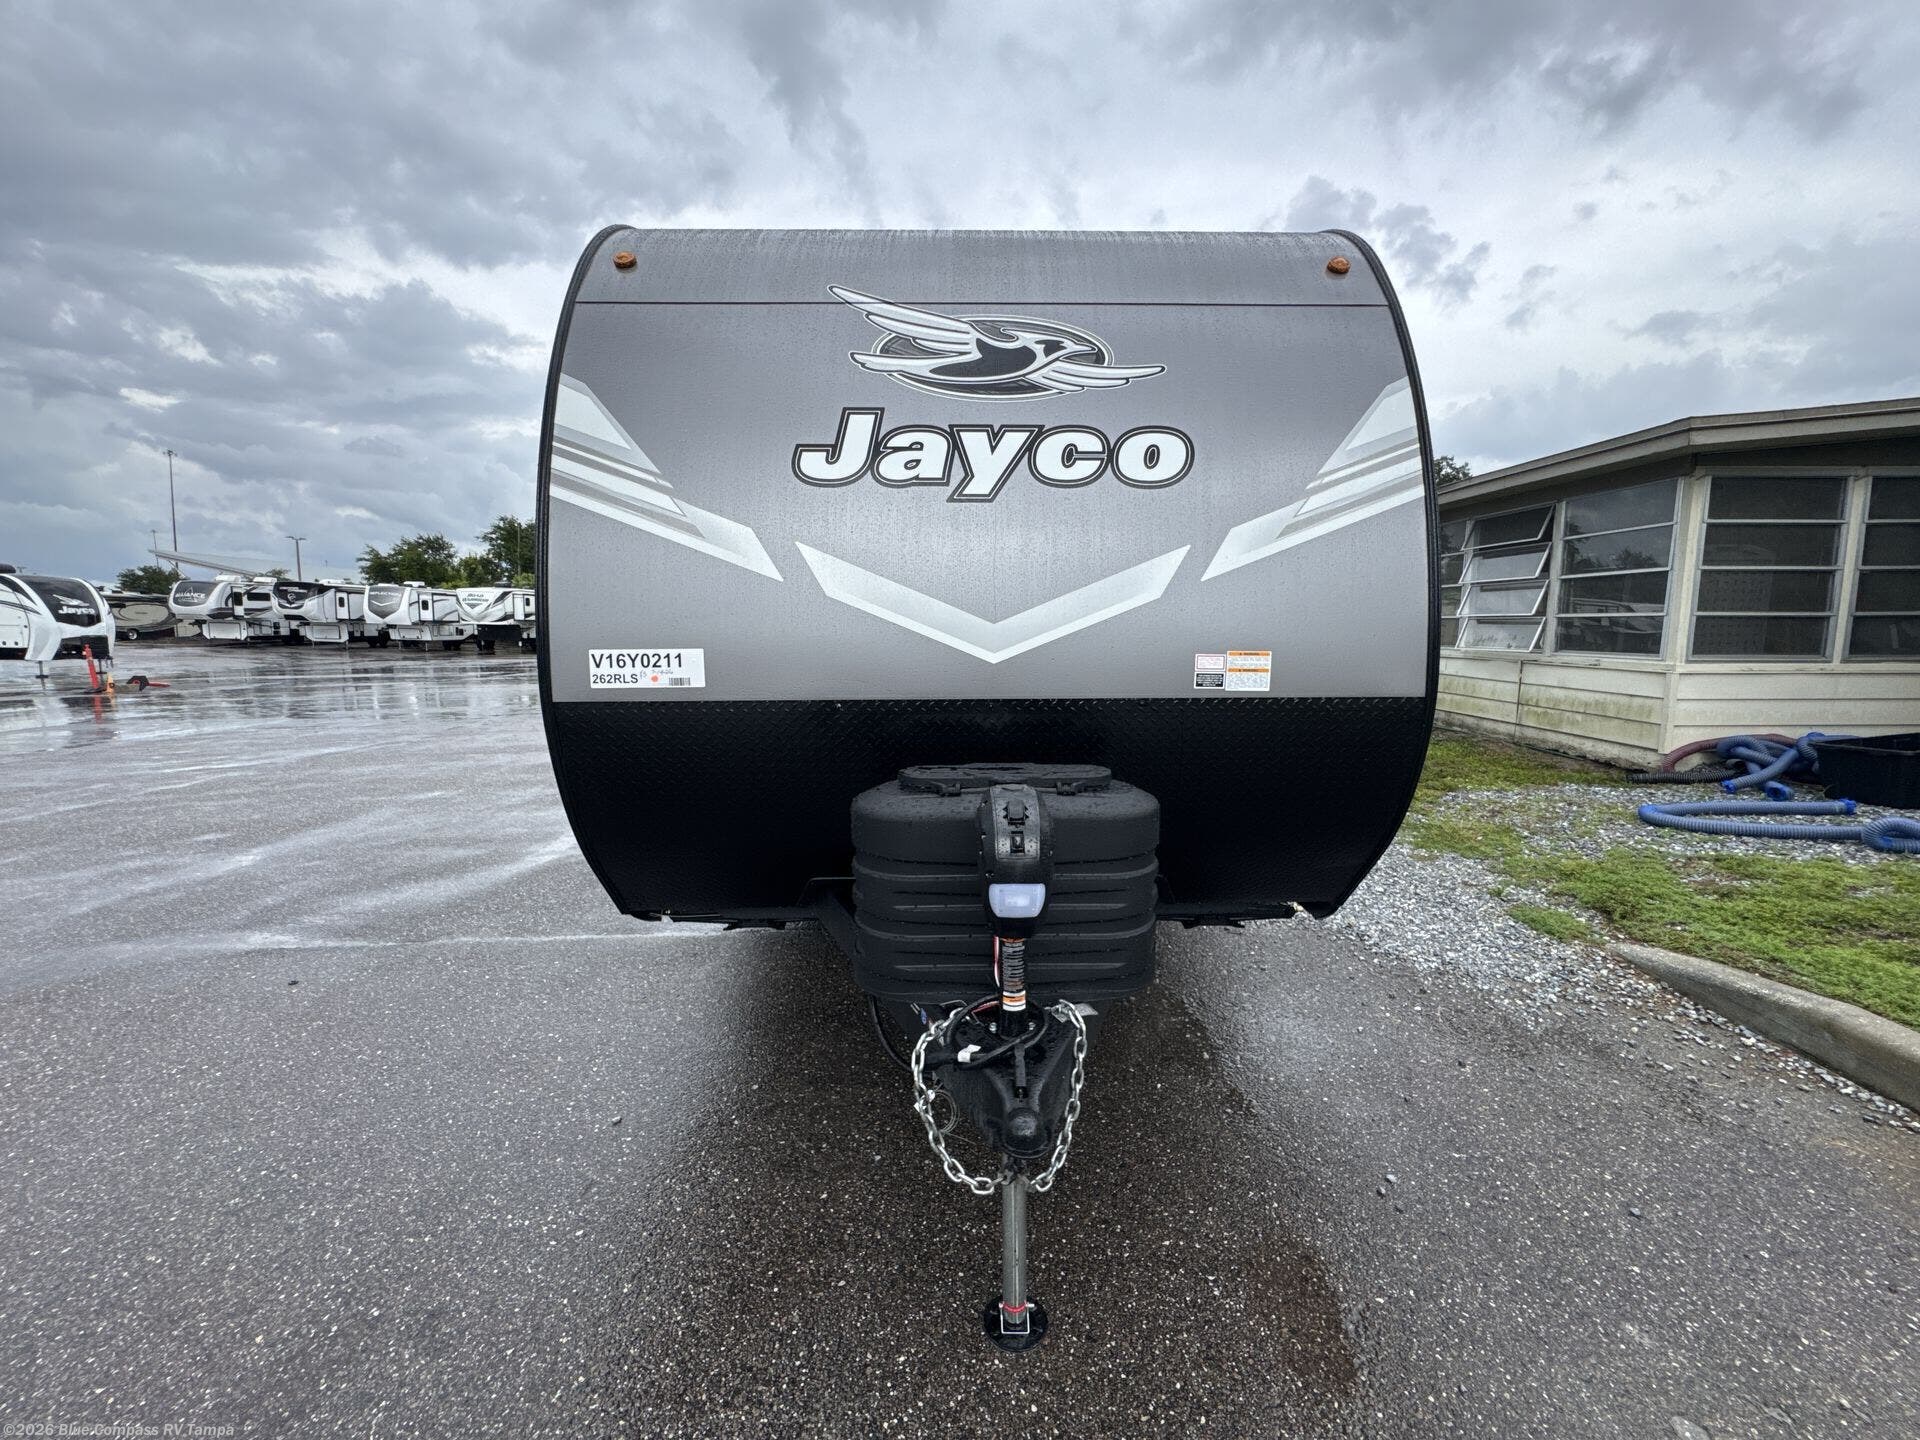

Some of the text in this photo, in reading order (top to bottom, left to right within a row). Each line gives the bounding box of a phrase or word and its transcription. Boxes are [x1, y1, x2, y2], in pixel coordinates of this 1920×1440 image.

[791, 406, 1196, 503] Jayco
[58, 605, 96, 615] Jayco
[591, 653, 682, 668] V16Y0211
[592, 674, 639, 684] 262RLS
